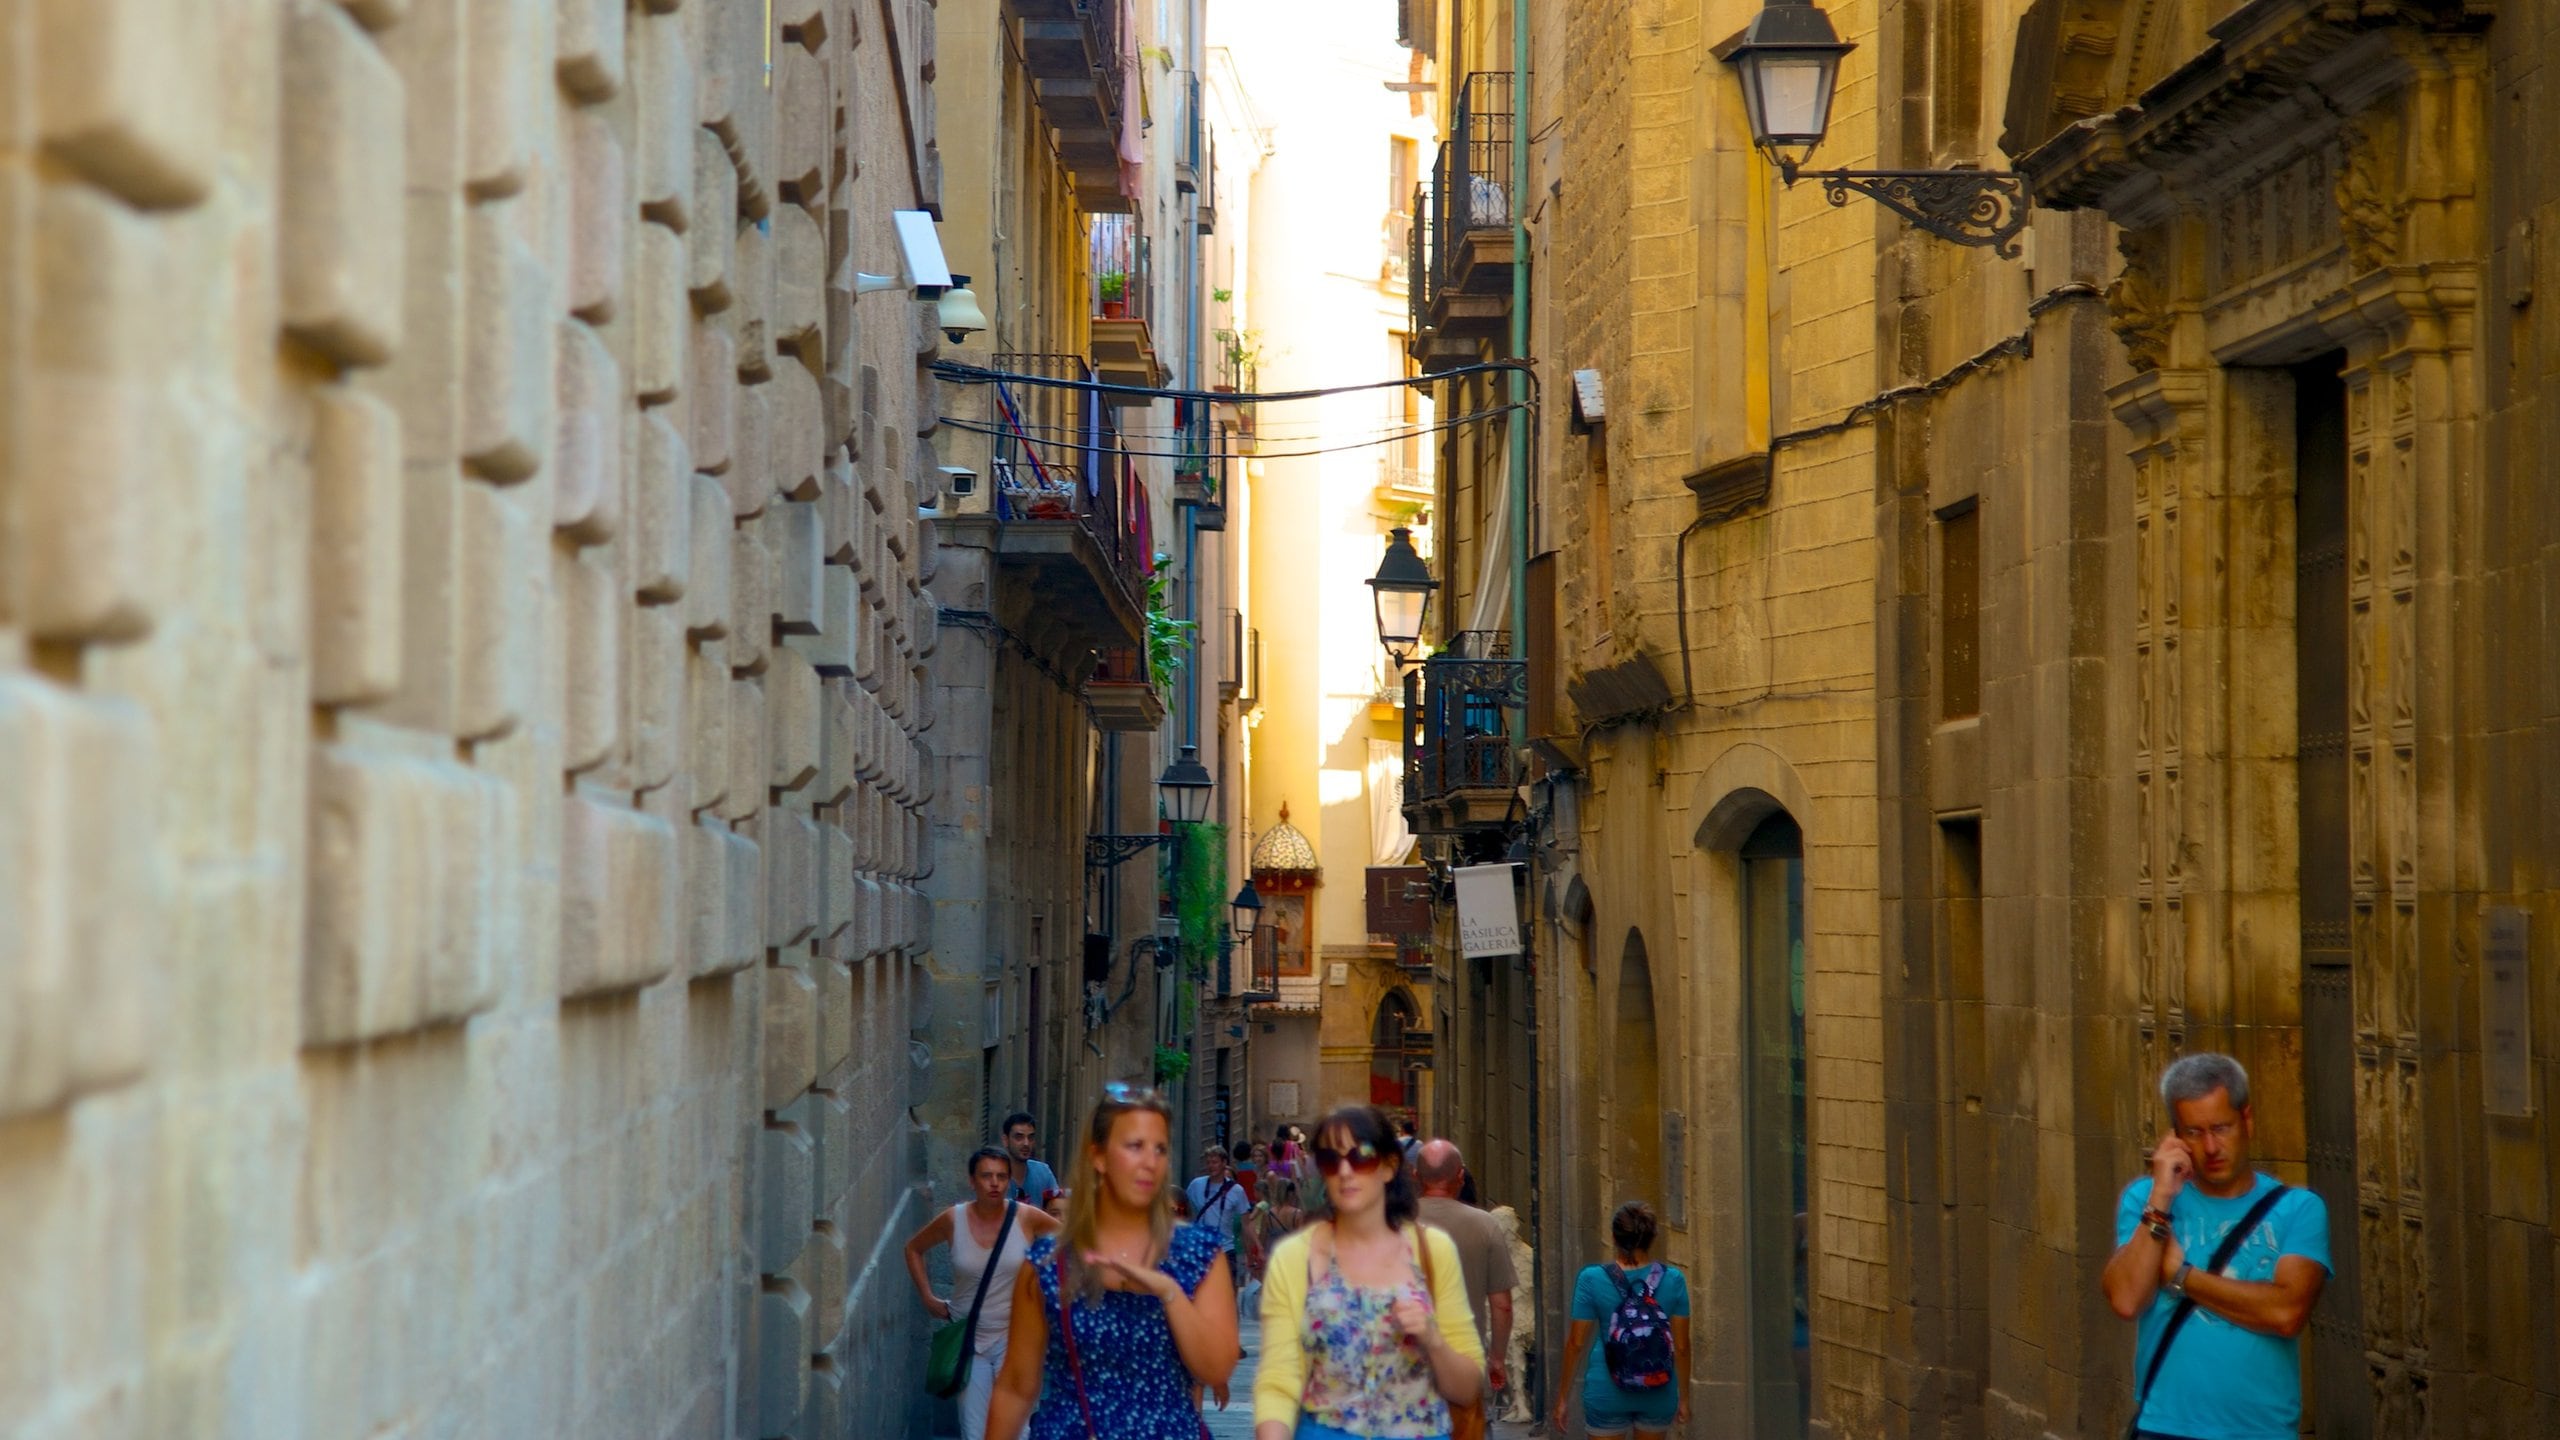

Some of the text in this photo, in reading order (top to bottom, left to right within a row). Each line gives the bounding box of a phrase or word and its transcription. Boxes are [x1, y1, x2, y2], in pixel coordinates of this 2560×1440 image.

[1462, 917, 1478, 927] LA
[1463, 926, 1516, 940] BASILICA
[1465, 940, 1518, 952] GALERIA
